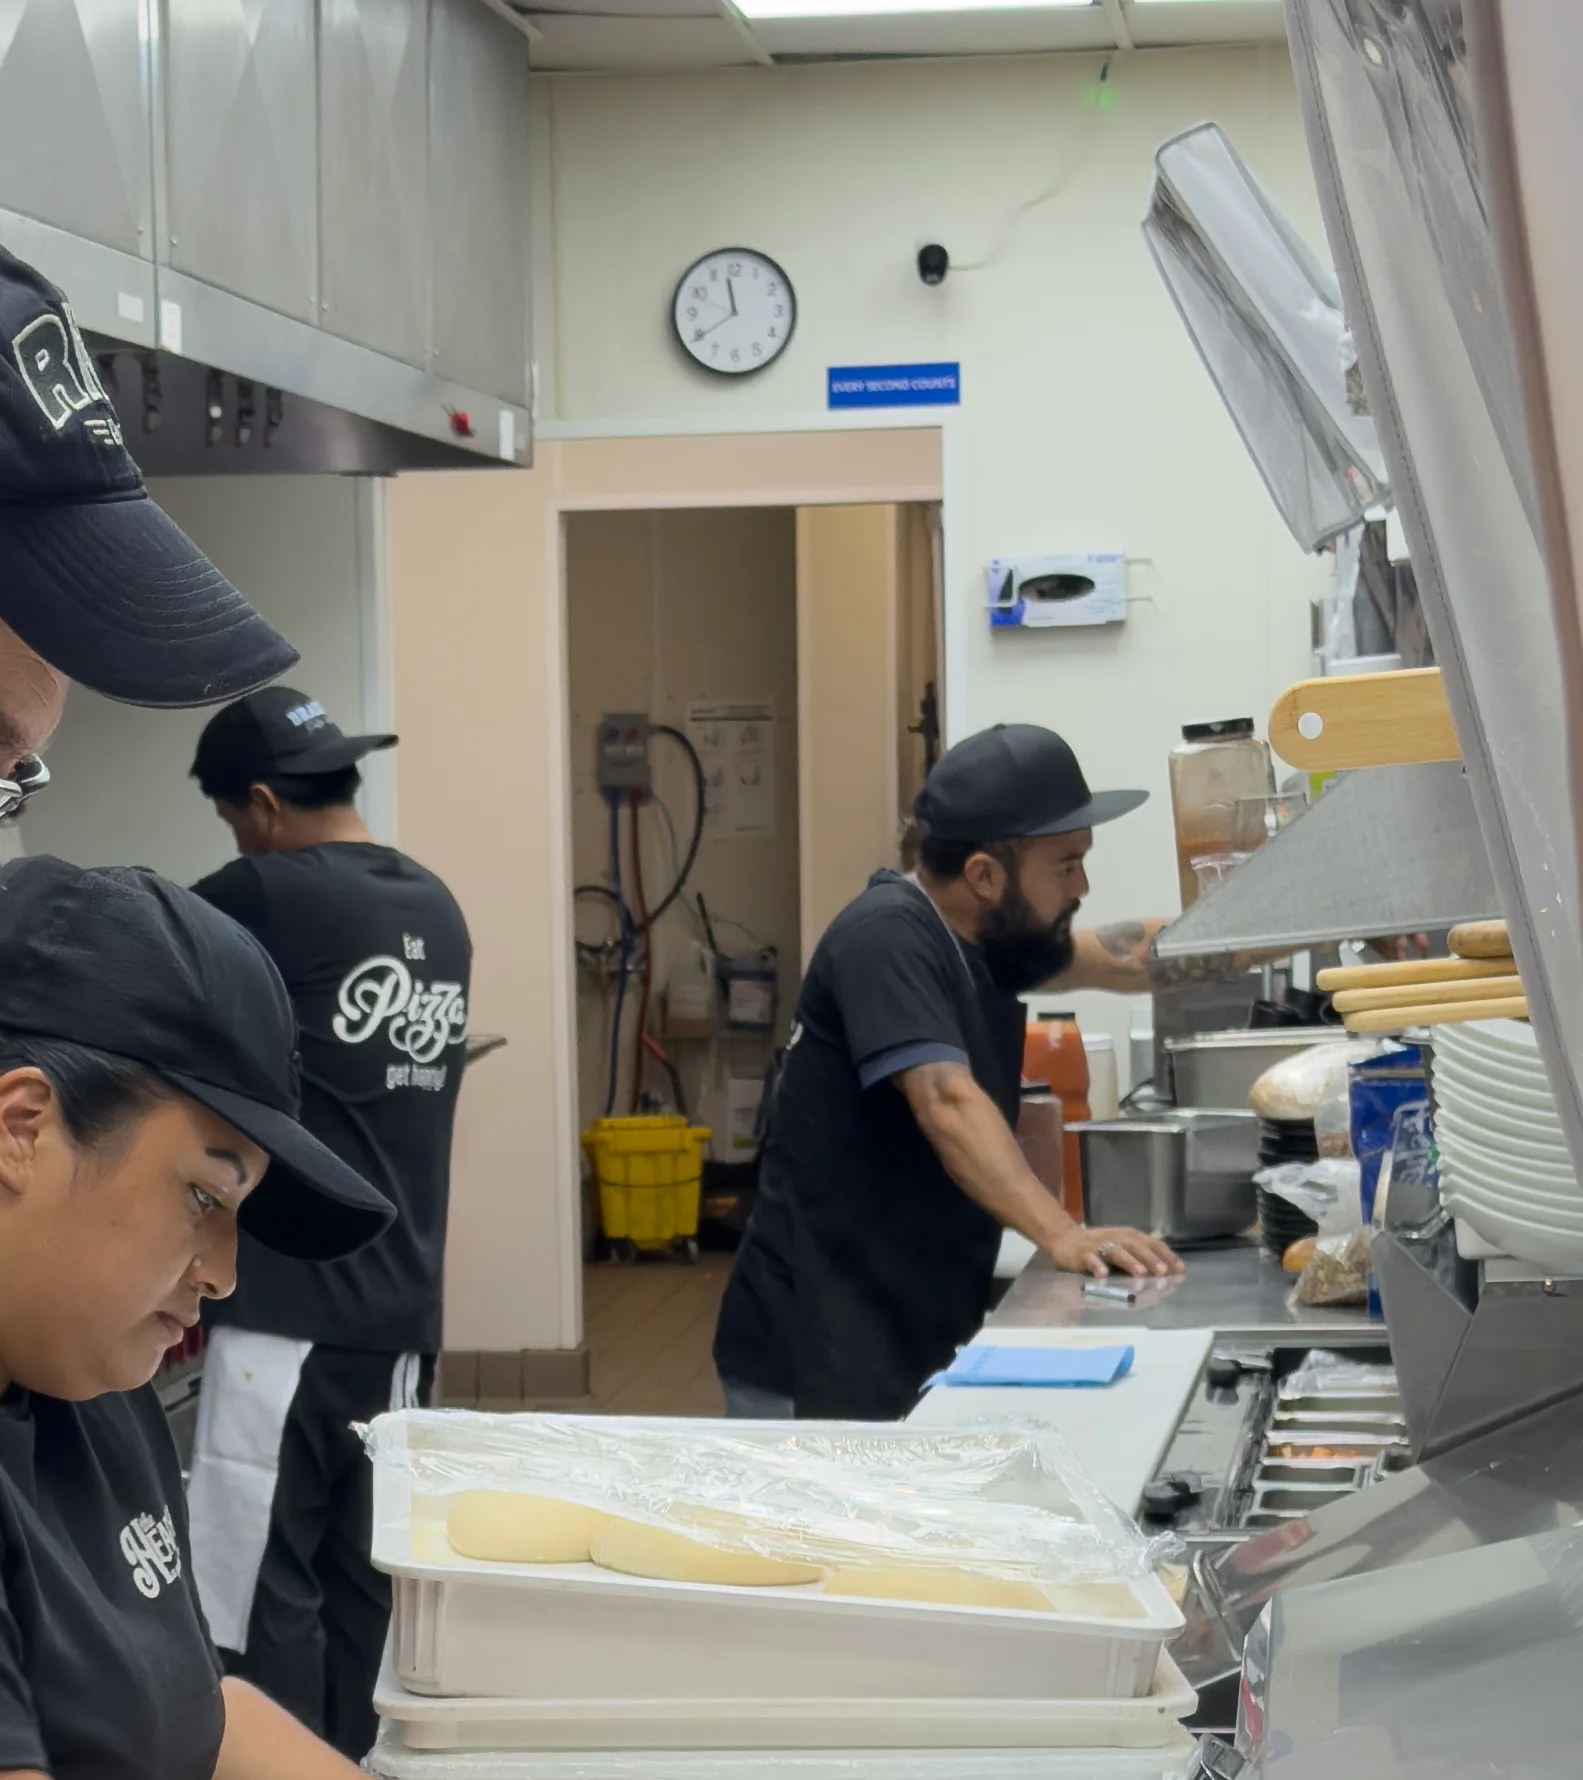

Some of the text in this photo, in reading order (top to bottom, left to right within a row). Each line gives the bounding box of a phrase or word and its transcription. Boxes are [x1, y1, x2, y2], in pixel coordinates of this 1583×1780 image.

[727, 262, 742, 278] 12
[766, 281, 777, 297] 2
[686, 306, 698, 322] 9
[773, 304, 784, 319] 3
[729, 348, 741, 363] 6
[332, 954, 467, 1064] Pizza
[386, 1063, 410, 1090] get
